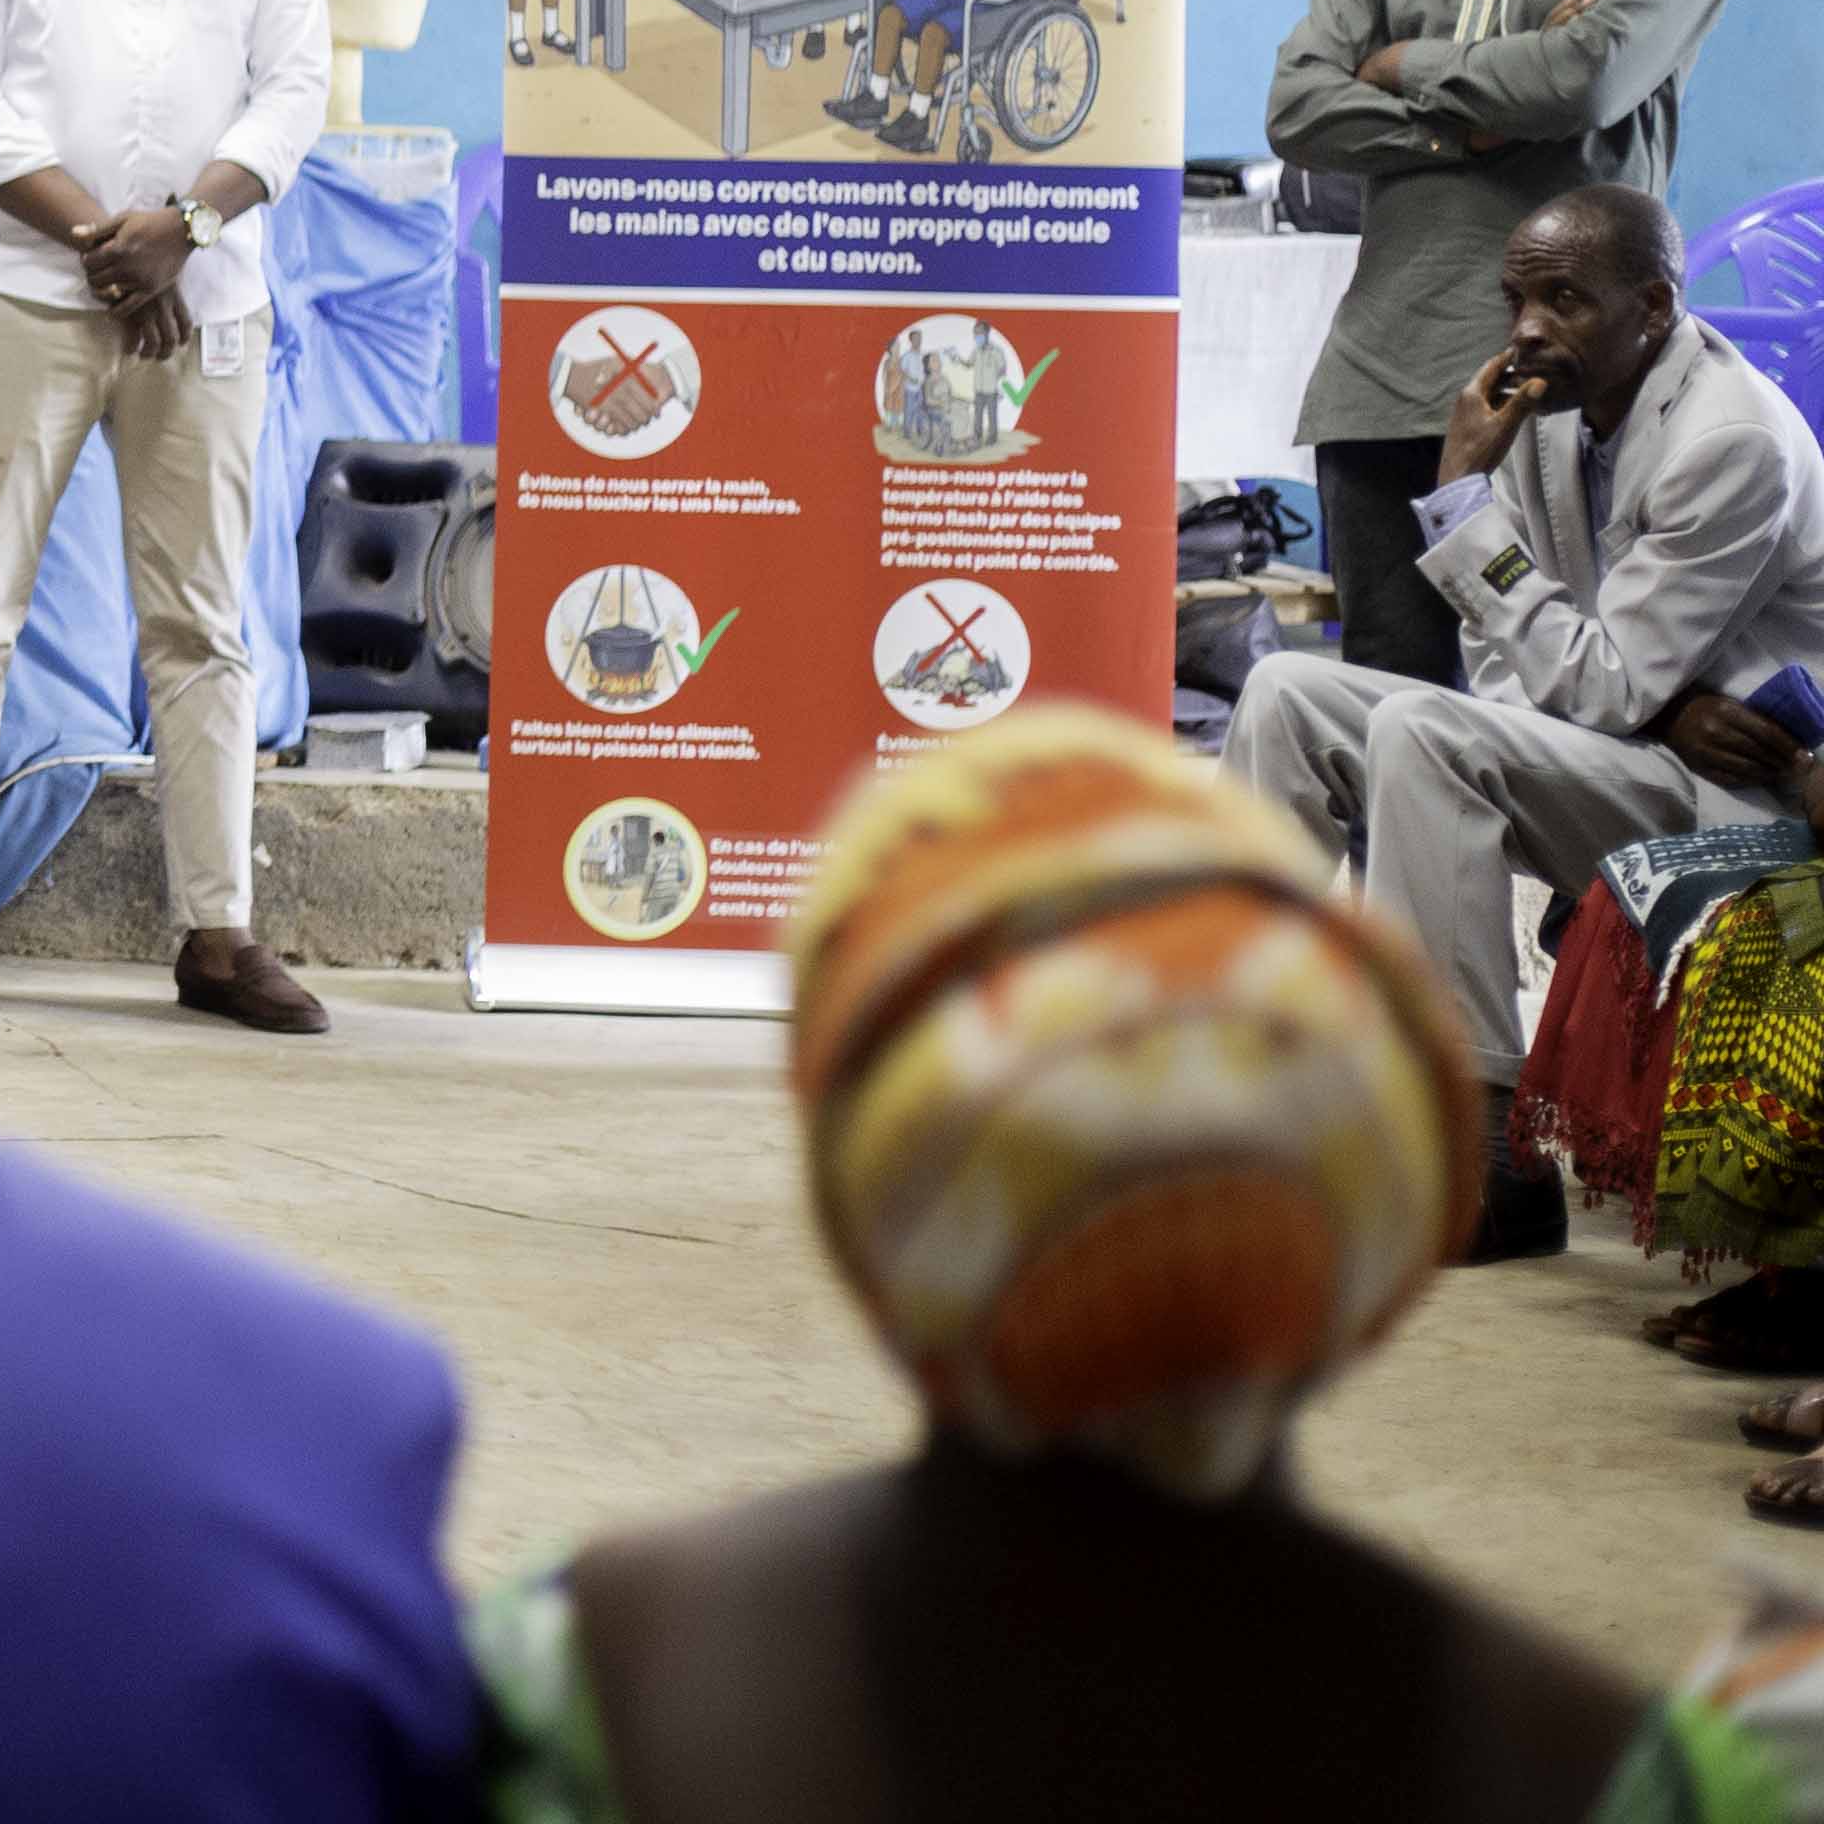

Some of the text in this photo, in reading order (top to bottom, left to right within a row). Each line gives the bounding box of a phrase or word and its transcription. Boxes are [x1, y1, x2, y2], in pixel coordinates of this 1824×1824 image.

[537, 173, 1140, 213] Lavons-nous correctement et régulièrement
[570, 207, 612, 235] les
[615, 208, 700, 236] mains
[702, 214, 770, 237] avec
[773, 210, 809, 238] de
[889, 217, 984, 246] propre
[986, 215, 1031, 248] qui
[1033, 216, 1112, 244] coule
[758, 245, 923, 274] et du savon.
[518, 470, 770, 497] Évitons de nous serrer la main,
[882, 467, 996, 486] Faisons-nous
[1070, 470, 1088, 488] la
[517, 491, 801, 515] de nous toucher les uns les autres.
[1051, 491, 1084, 509] des
[881, 508, 944, 527] thermo
[989, 512, 1019, 530] par
[1020, 510, 1052, 528] des
[1054, 512, 1122, 533] équipes
[1026, 534, 1049, 550] au
[1049, 534, 1094, 553] point
[953, 552, 972, 569] et
[973, 552, 1018, 573] point
[1019, 552, 1042, 571] de
[511, 719, 754, 743] Faites bien cuire les aliments,
[510, 738, 573, 756] surtout
[591, 741, 659, 760] poisson
[660, 742, 679, 759] et
[680, 741, 697, 759] la
[697, 742, 760, 761] viande.
[710, 837, 732, 856] En
[734, 840, 765, 856] cas
[766, 838, 789, 857] de
[709, 858, 785, 876] douleurs
[708, 900, 765, 918] centre
